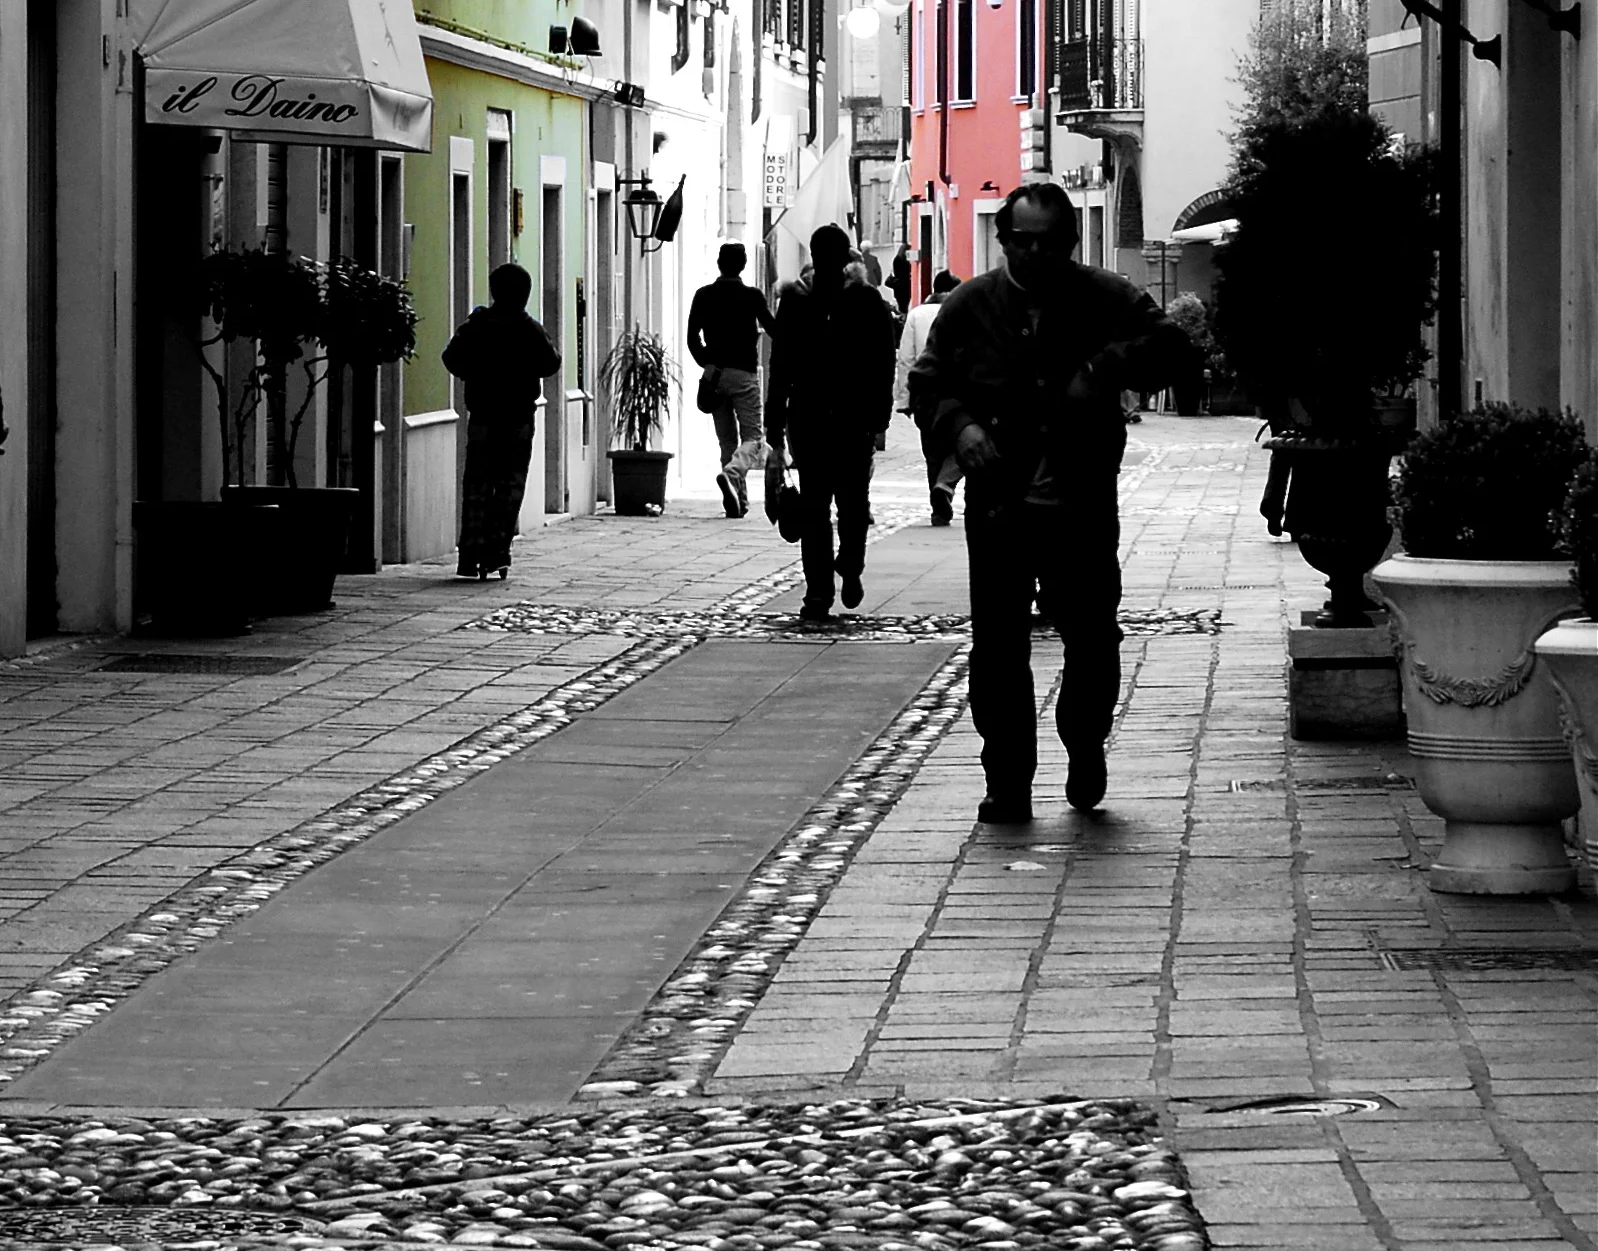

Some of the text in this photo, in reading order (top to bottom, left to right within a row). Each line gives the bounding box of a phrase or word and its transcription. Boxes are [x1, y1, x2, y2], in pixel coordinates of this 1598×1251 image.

[161, 76, 218, 114] il
[224, 74, 359, 123] Daino
[766, 155, 776, 204] MODEL
[776, 155, 786, 204] STORE
